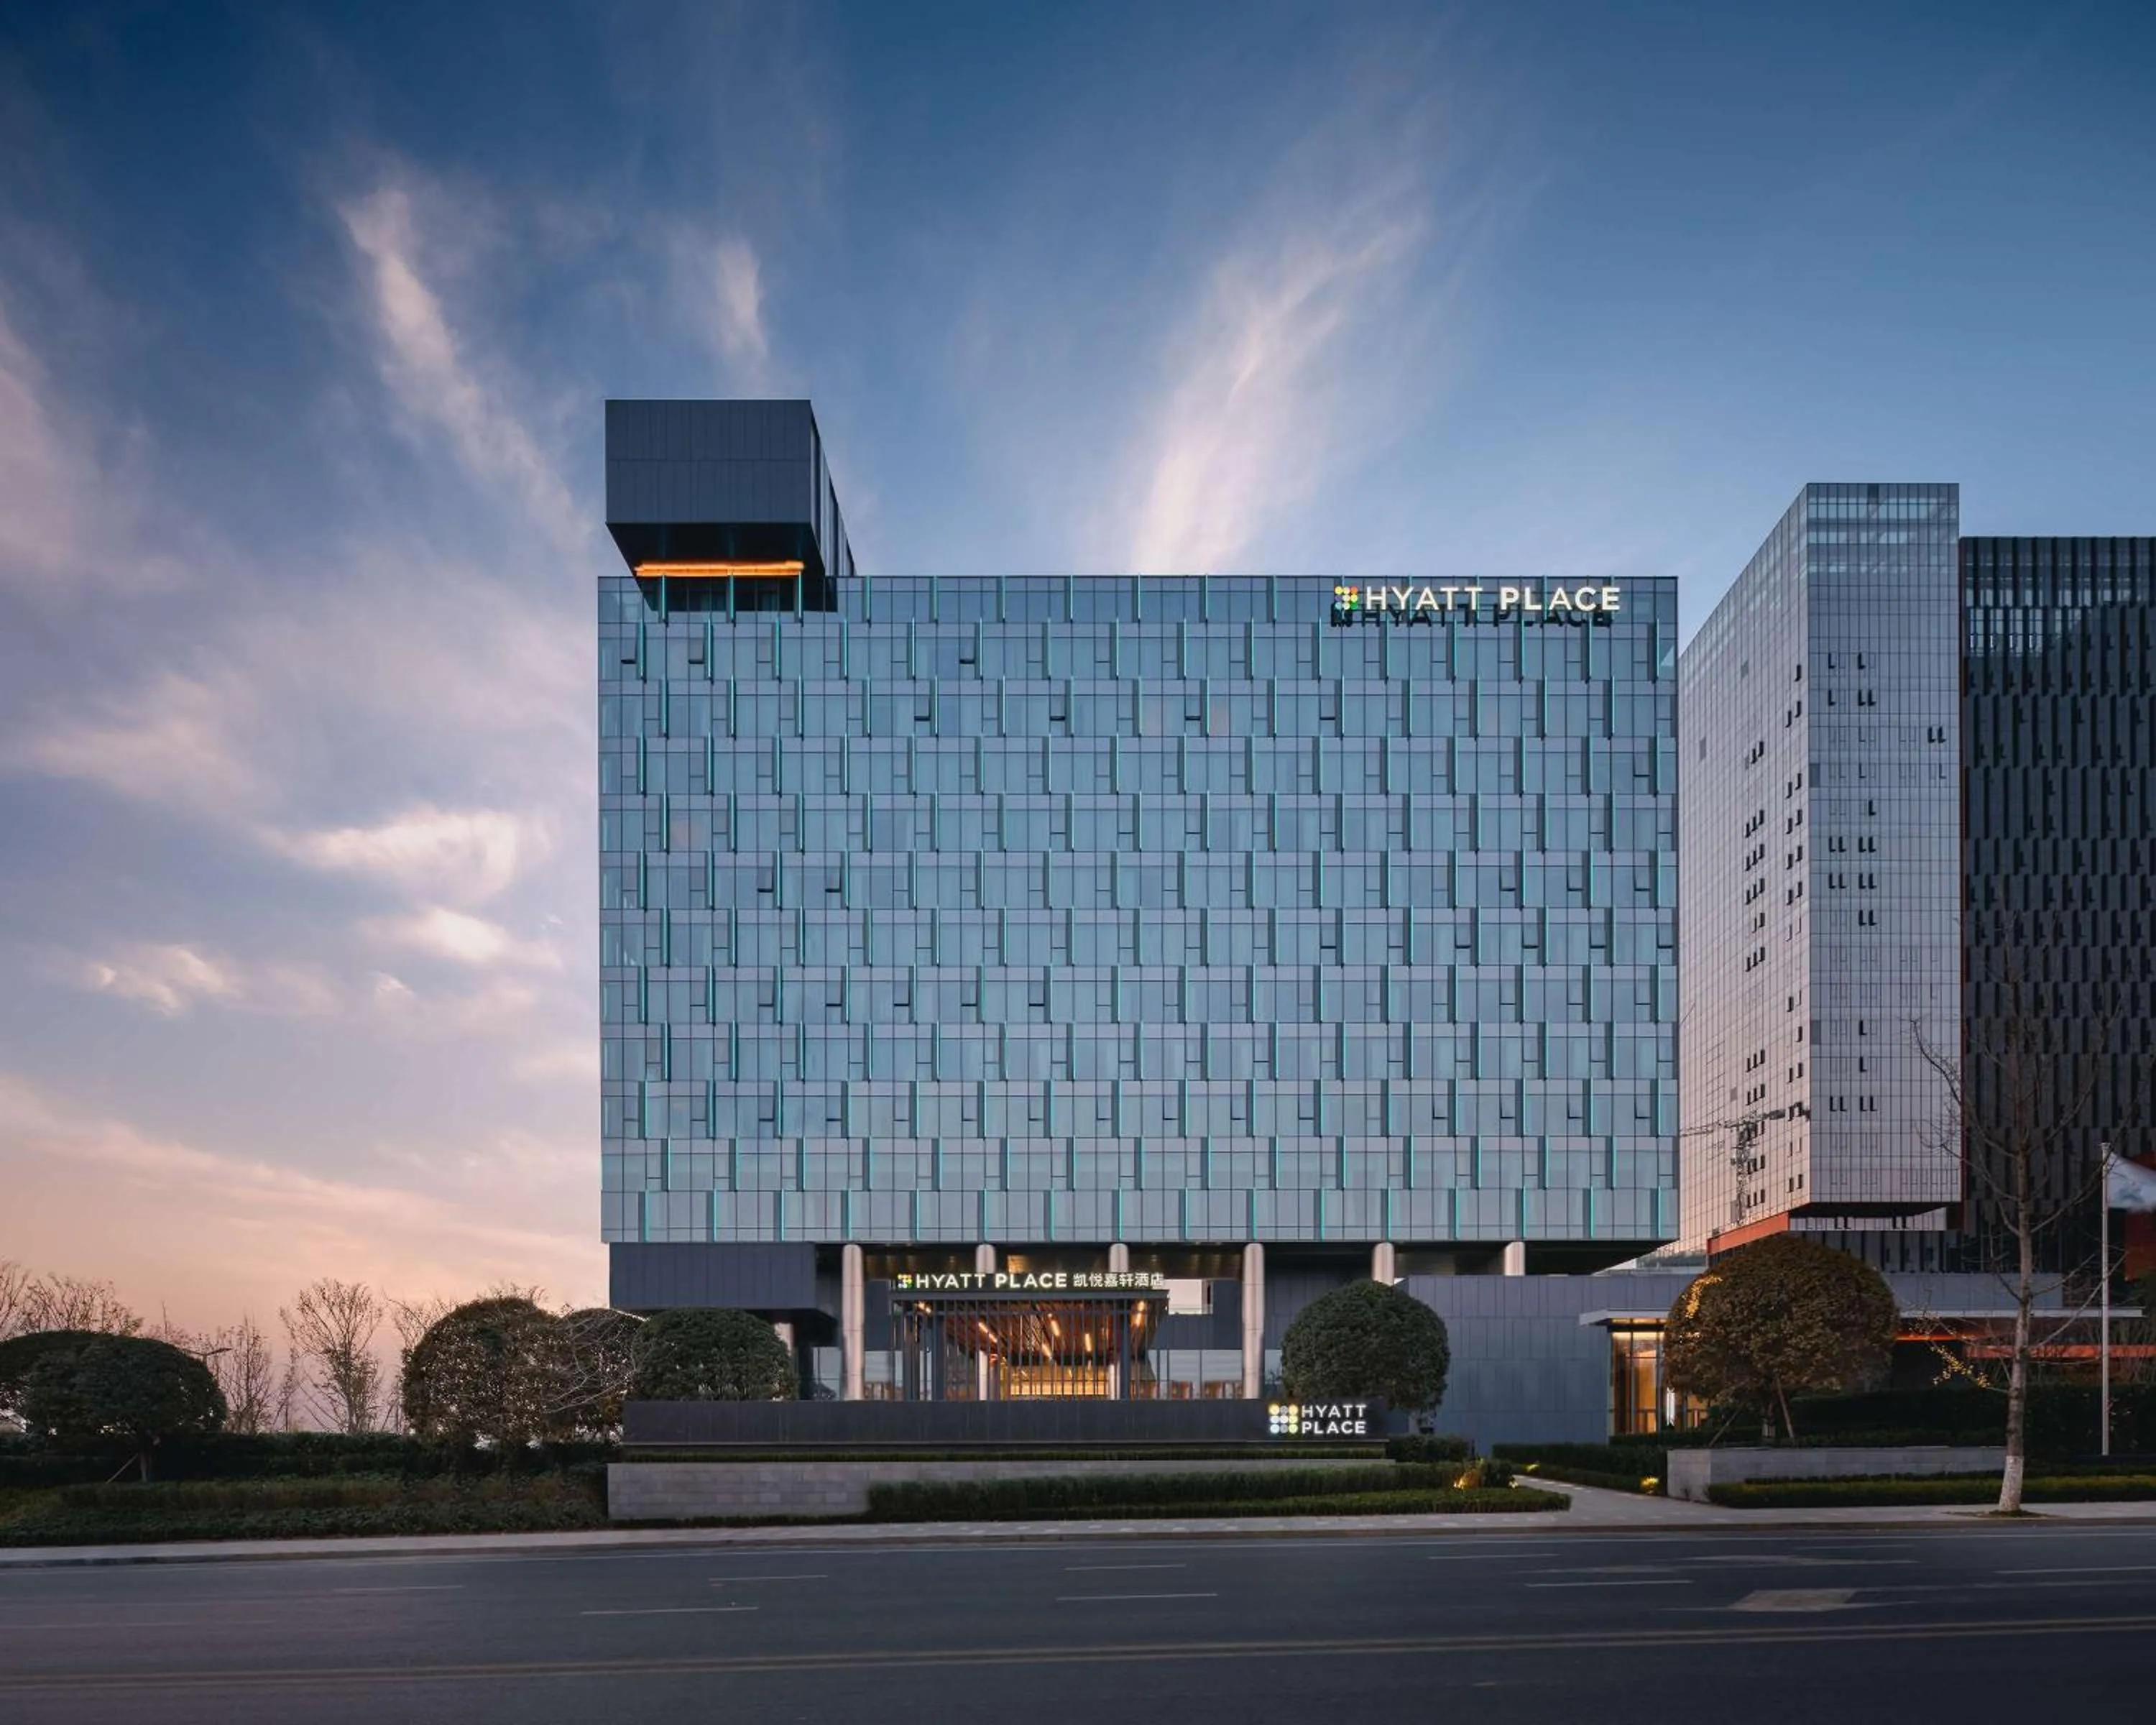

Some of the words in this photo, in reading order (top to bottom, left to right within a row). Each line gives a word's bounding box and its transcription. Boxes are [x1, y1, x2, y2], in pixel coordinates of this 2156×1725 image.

[1365, 586, 1483, 610] HYATT
[1500, 586, 1621, 611] PLACE
[916, 1273, 987, 1289] HYATT
[995, 1273, 1067, 1289] PLACE
[1073, 1272, 1164, 1288] 凯悦嘉轩酒店
[1302, 1404, 1367, 1418] HYATT
[1302, 1421, 1366, 1434] PLACE
